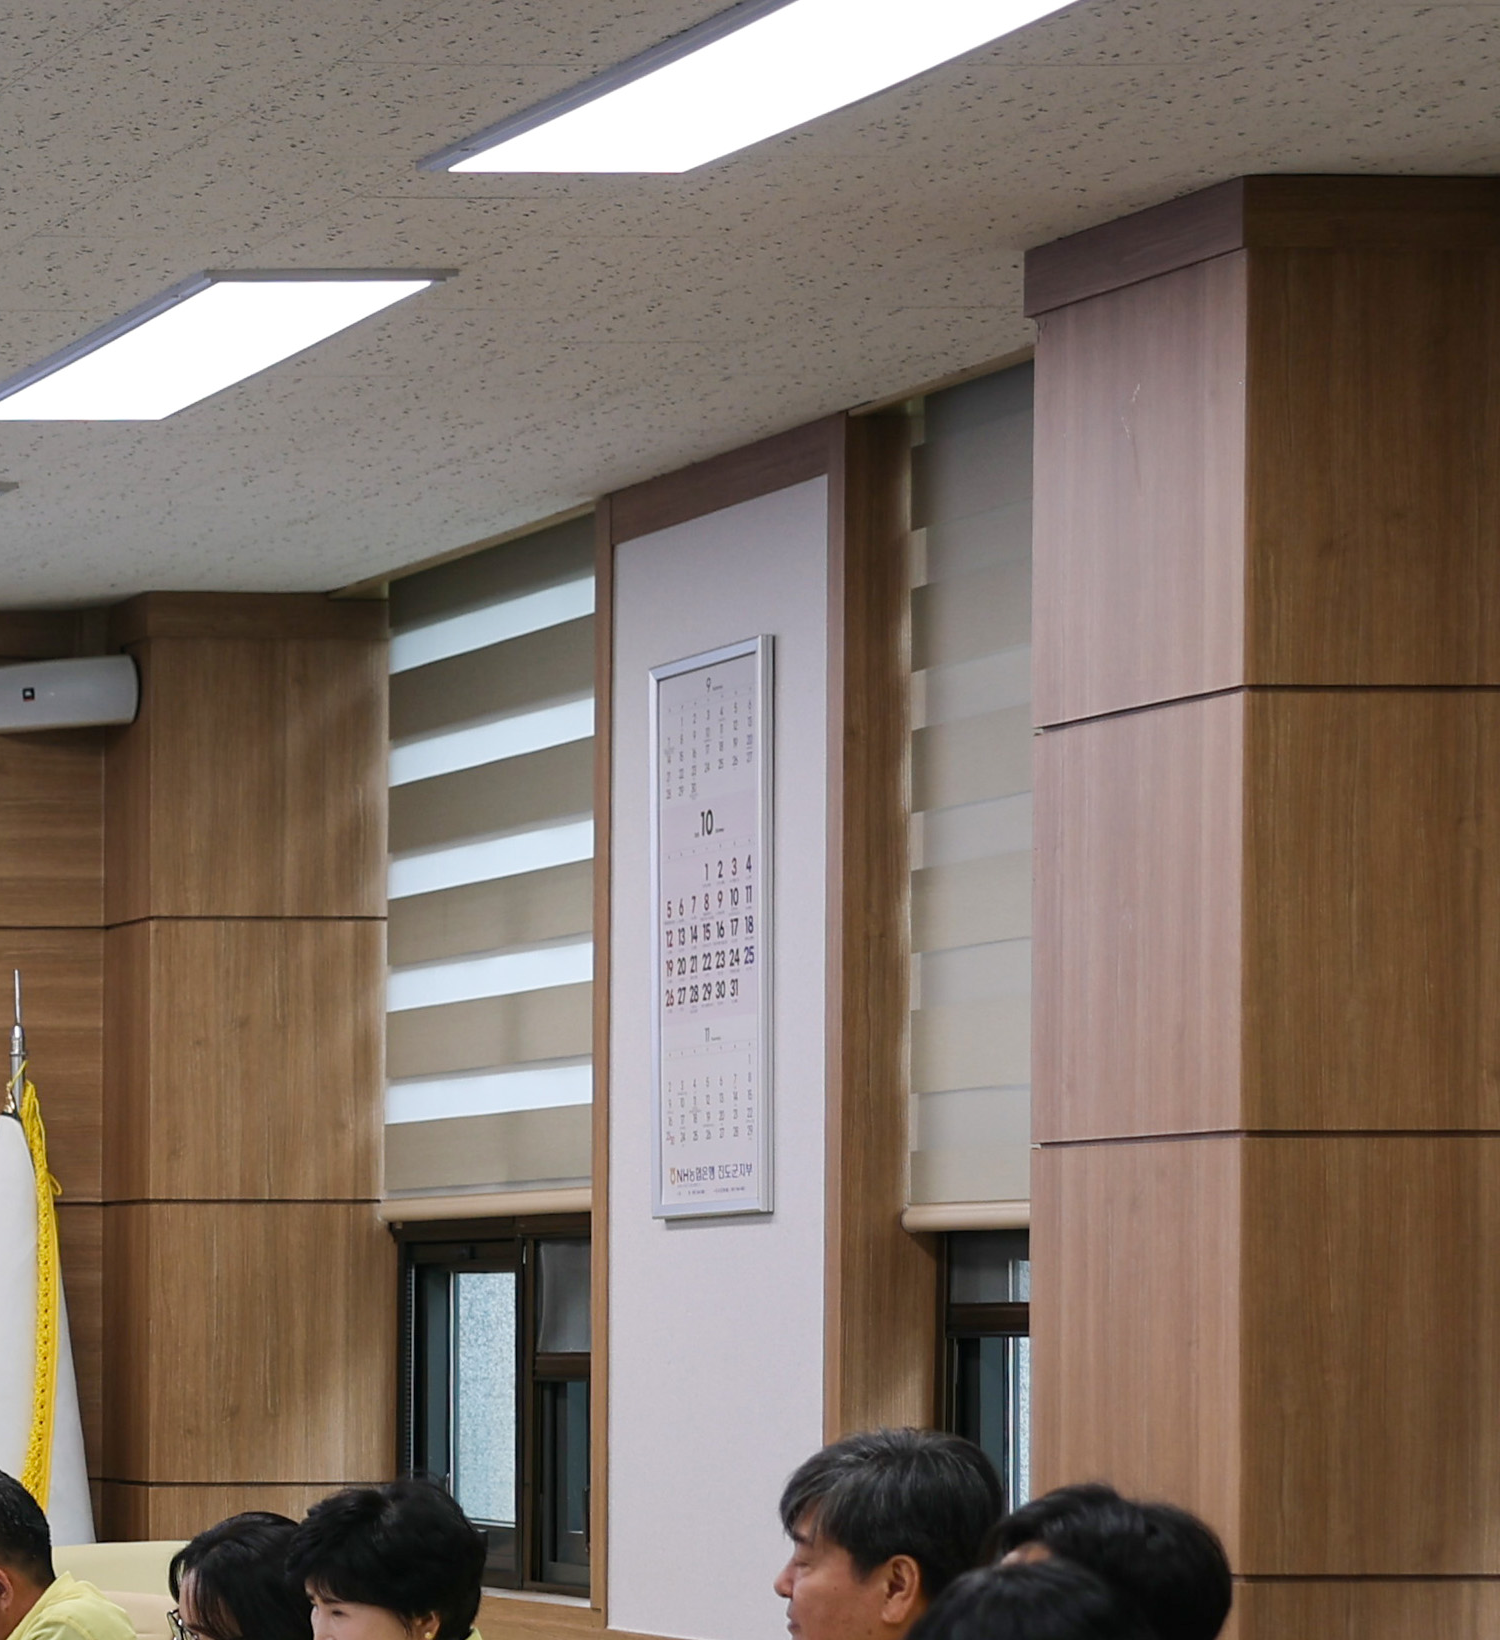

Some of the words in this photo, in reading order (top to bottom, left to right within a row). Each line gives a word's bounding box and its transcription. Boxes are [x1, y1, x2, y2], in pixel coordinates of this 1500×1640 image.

[706, 677, 711, 692] 9
[700, 809, 714, 836] 10
[705, 863, 709, 881] 1
[717, 860, 723, 879] 2
[731, 857, 737, 876] 3
[746, 854, 752, 873] 4
[667, 901, 672, 918] 5
[679, 898, 684, 916] 6
[691, 896, 696, 914] 7
[704, 893, 709, 911] 8
[718, 891, 723, 908] 9
[730, 887, 739, 906] 10
[746, 885, 752, 903] 11
[666, 931, 673, 948] 12
[678, 928, 685, 946] 13
[690, 925, 697, 943] 14
[703, 923, 711, 941] 15
[716, 920, 724, 938] 16
[730, 917, 739, 936] 17
[745, 915, 754, 934] 18
[666, 960, 673, 977] 19
[677, 957, 686, 975] 20
[690, 955, 697, 973] 21
[702, 953, 711, 971] 22
[715, 950, 725, 969] 23
[729, 948, 740, 967] 24
[744, 945, 755, 965] 25
[666, 989, 674, 1007] 26
[677, 987, 686, 1005] 27
[690, 984, 698, 1003] 28
[702, 982, 712, 1001] 29
[716, 980, 726, 999] 30
[730, 978, 739, 997] 31
[677, 1165, 715, 1183] NH농협은행
[718, 1163, 753, 1180] 진도군지부
